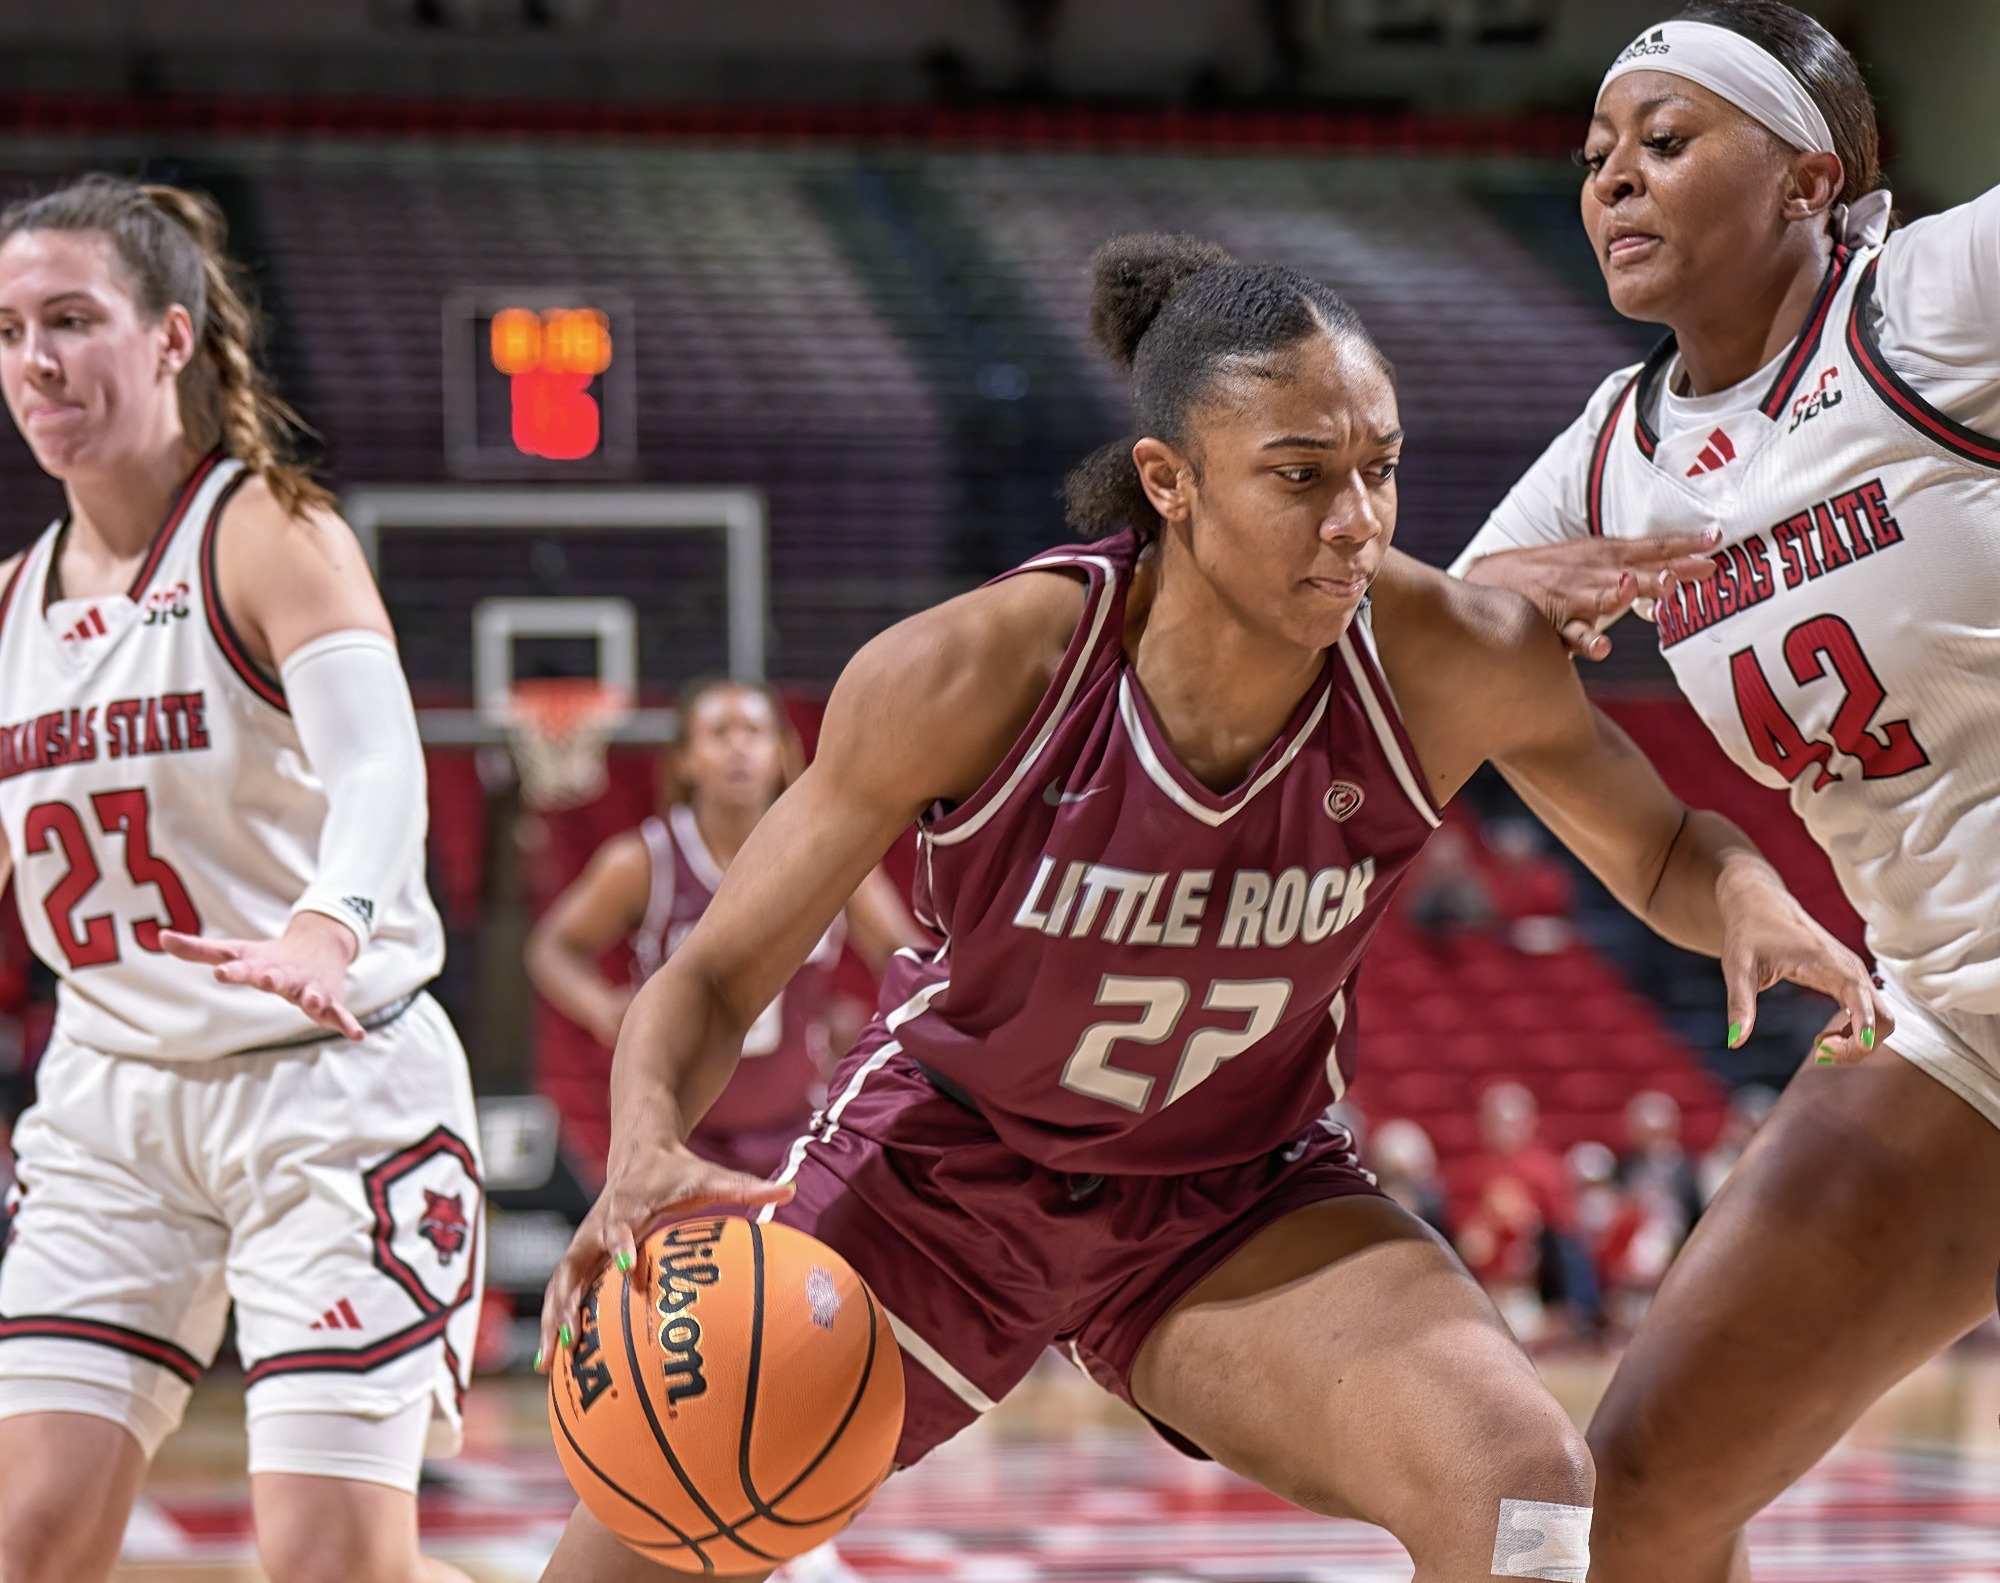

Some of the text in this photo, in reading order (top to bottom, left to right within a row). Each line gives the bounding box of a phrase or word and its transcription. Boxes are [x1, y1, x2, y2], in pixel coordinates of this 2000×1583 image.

[1772, 478, 1904, 590] STATE
[106, 689, 211, 760] STATE
[1729, 613, 1930, 793] 42
[25, 787, 203, 970] 23
[1012, 854, 1377, 949] LITTLE ROCK
[656, 1218, 727, 1406] Wilson
